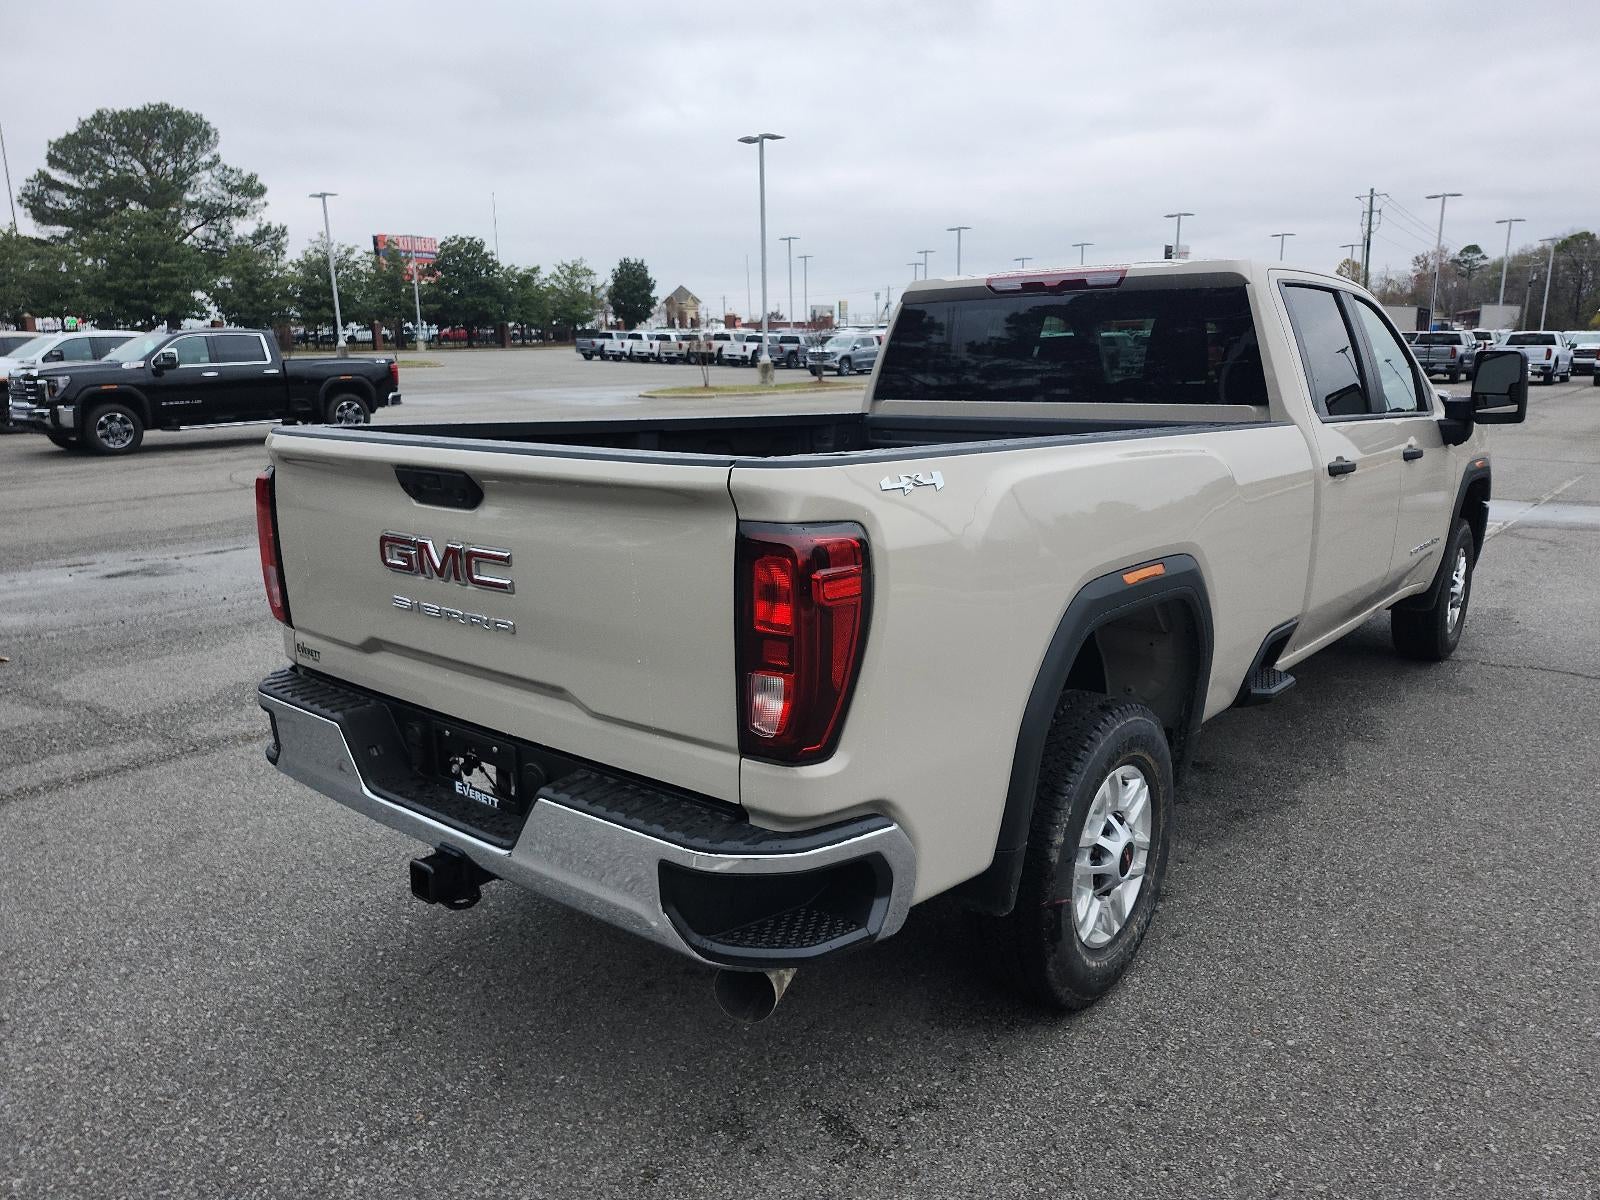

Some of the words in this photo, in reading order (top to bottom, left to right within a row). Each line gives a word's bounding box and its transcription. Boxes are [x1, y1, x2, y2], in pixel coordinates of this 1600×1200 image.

[379, 529, 516, 595] GMC
[392, 594, 517, 634] SIERRA
[455, 780, 500, 809] EVERETT
